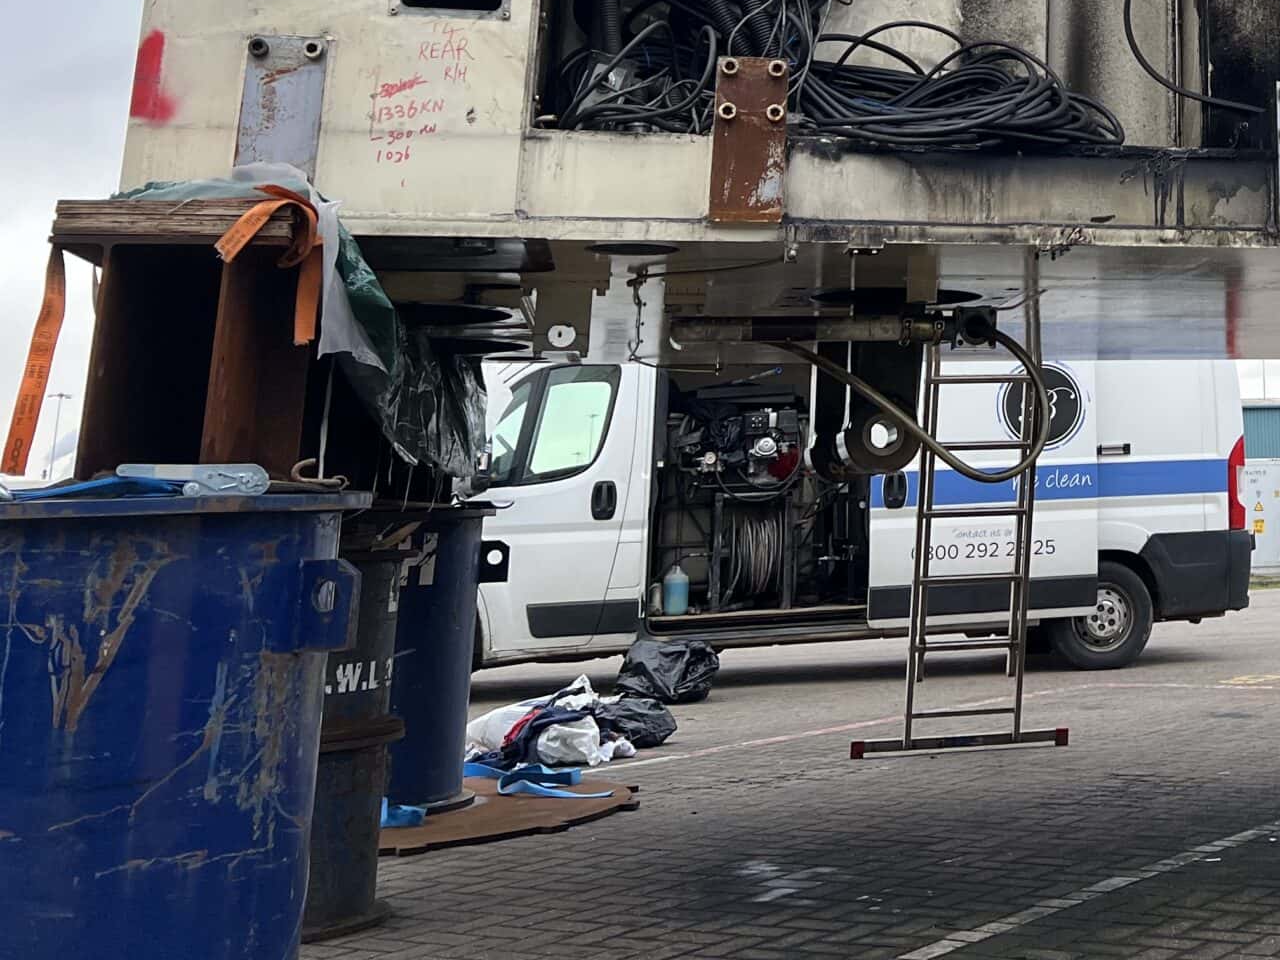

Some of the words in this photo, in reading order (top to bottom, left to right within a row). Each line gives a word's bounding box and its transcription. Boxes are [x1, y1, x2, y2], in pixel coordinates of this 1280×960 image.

[418, 38, 476, 61] REAR
[1046, 468, 1092, 489] clean
[911, 543, 959, 561] 800
[965, 542, 999, 558] 292
[1006, 539, 1056, 556] 225
